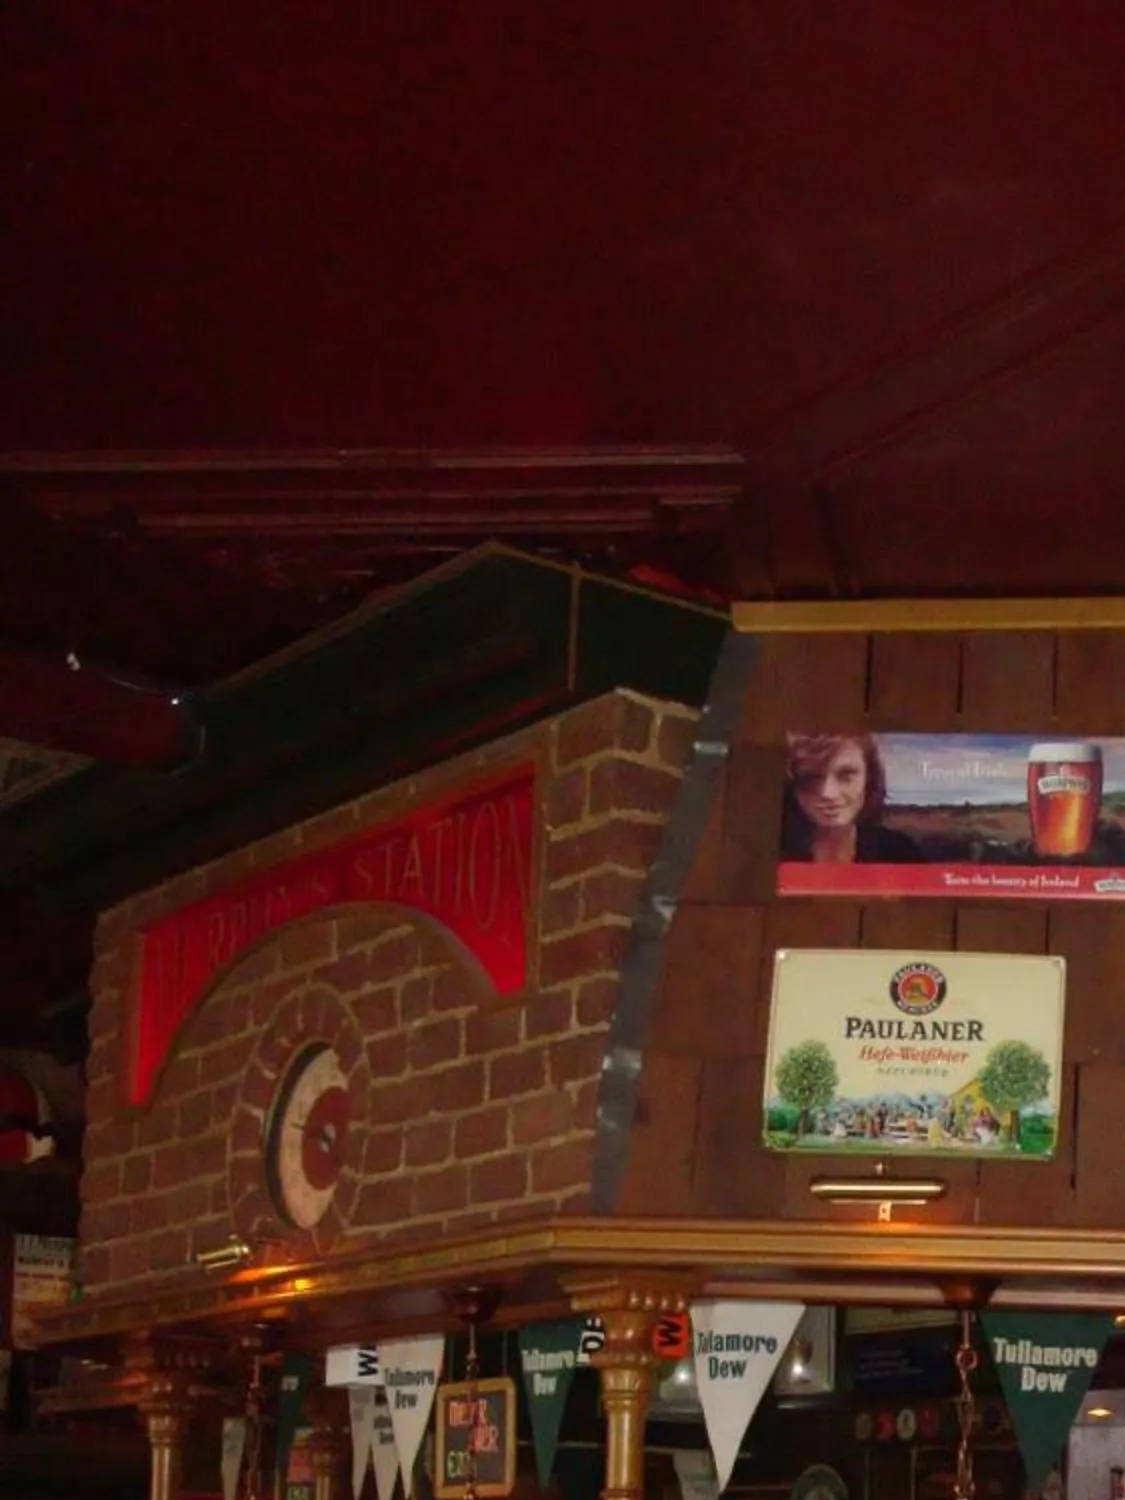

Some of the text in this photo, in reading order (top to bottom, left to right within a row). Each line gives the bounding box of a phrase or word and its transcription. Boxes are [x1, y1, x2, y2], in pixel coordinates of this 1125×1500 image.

[354, 788, 530, 946] STATION
[845, 1016, 985, 1042] PAULANER
[994, 1337, 1098, 1368] Tullamore
[708, 1355, 747, 1380] Dew
[1021, 1366, 1068, 1393] Dew
